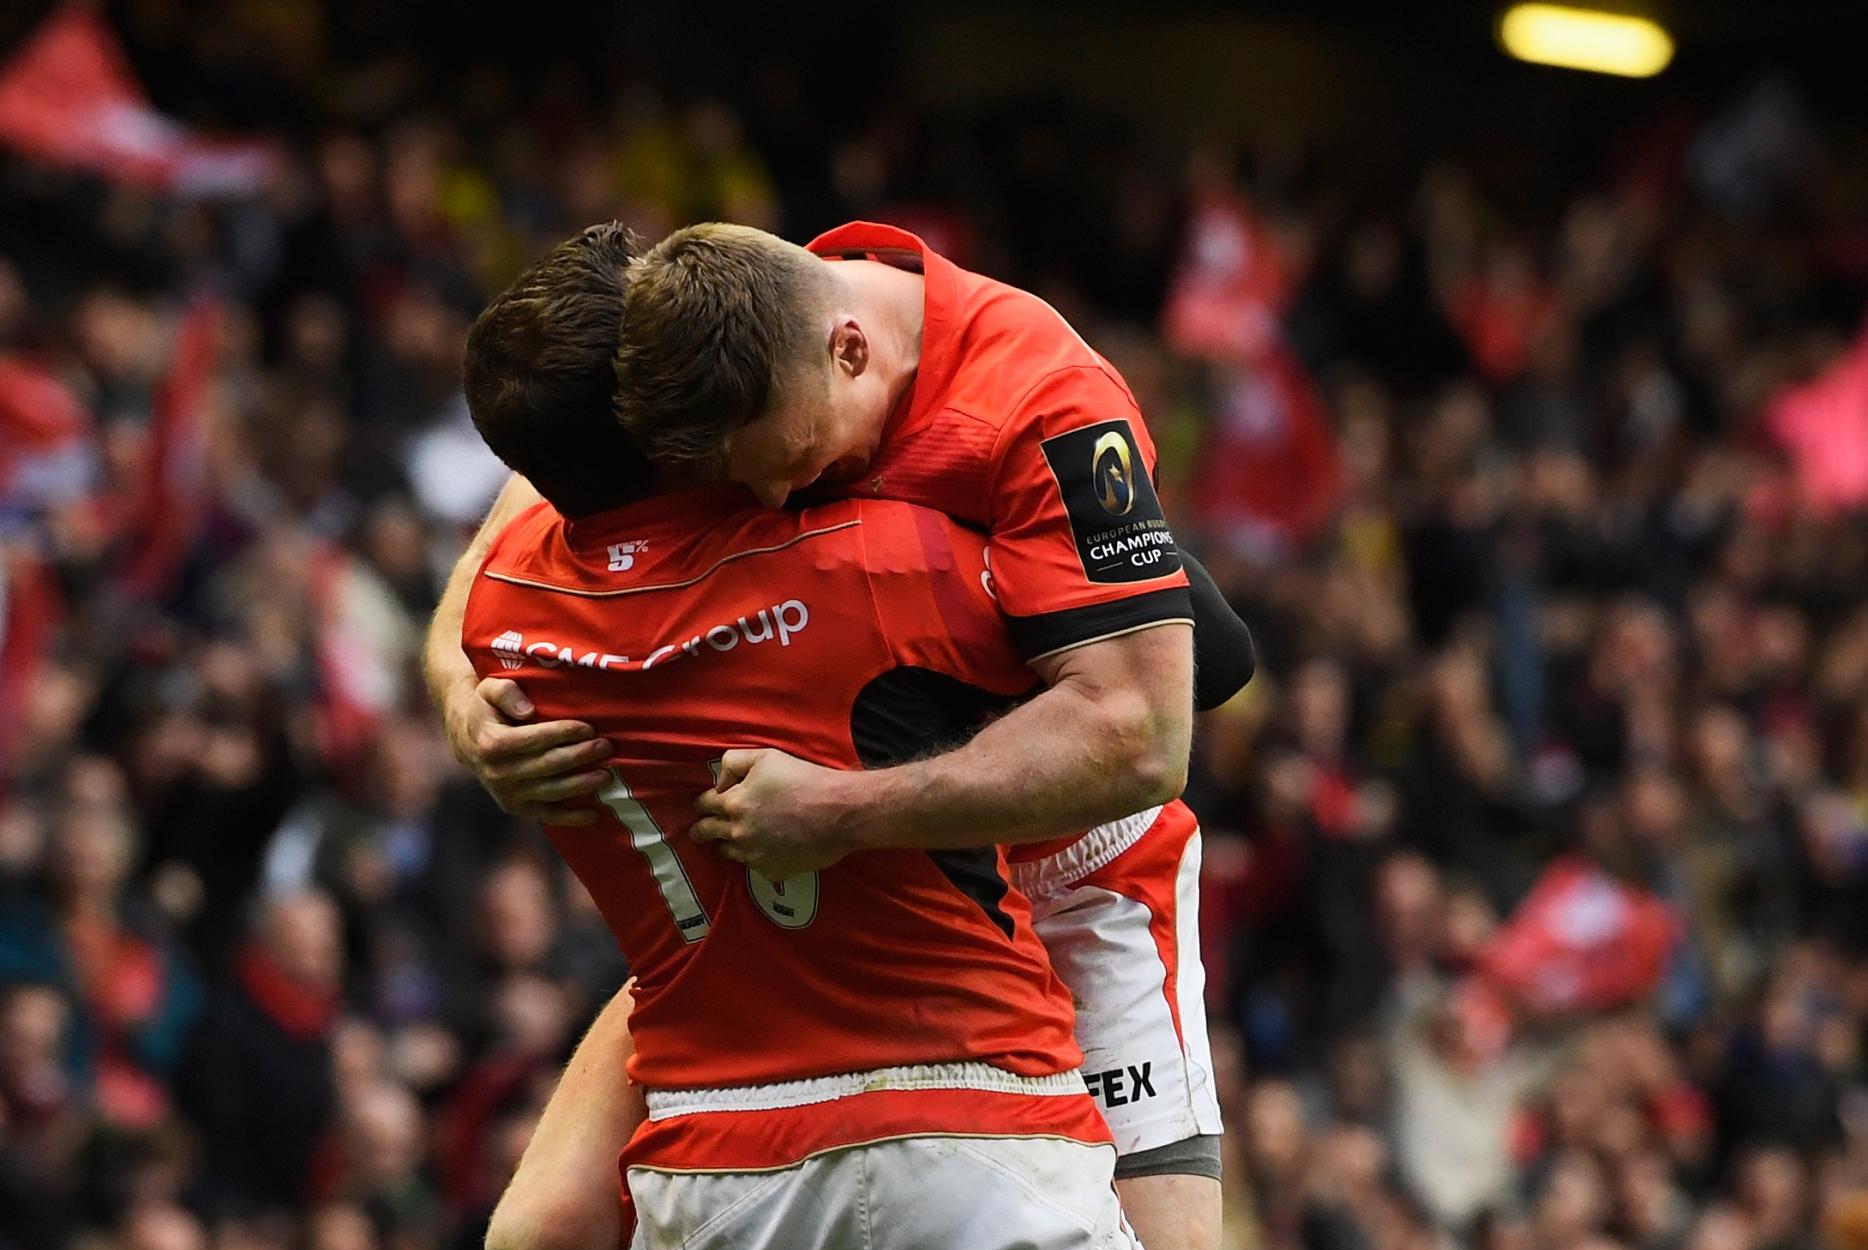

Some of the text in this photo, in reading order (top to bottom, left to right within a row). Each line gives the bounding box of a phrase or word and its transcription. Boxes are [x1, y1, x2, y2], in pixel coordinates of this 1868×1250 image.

[1086, 520, 1146, 545] EUROPEAN
[1090, 531, 1174, 561] CHAMPIONS
[1131, 549, 1162, 567] CUP
